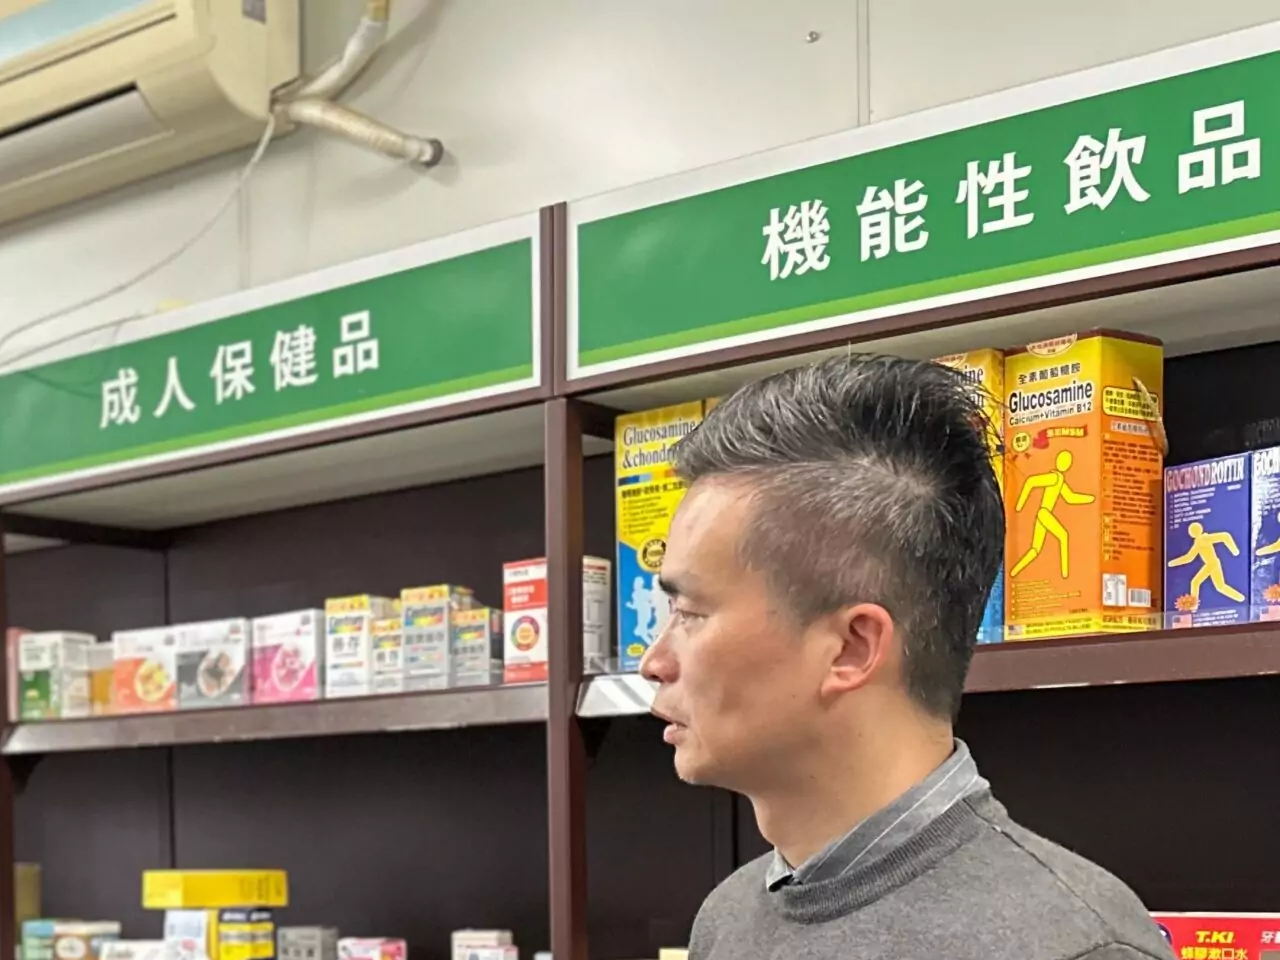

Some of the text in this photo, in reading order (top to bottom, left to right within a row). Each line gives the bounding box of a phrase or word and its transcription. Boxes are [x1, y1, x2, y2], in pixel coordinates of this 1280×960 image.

[761, 100, 1261, 281] 機能性飲品
[99, 310, 380, 430] 成人保健品
[1009, 380, 1093, 413] Glucosamine
[1009, 406, 1075, 426] Calcium+Vitamin
[1076, 402, 1092, 413] B12
[623, 418, 696, 446] Glucosamine
[1167, 457, 1245, 492] GOCHONDROITIN
[1195, 930, 1235, 943] T.KI
